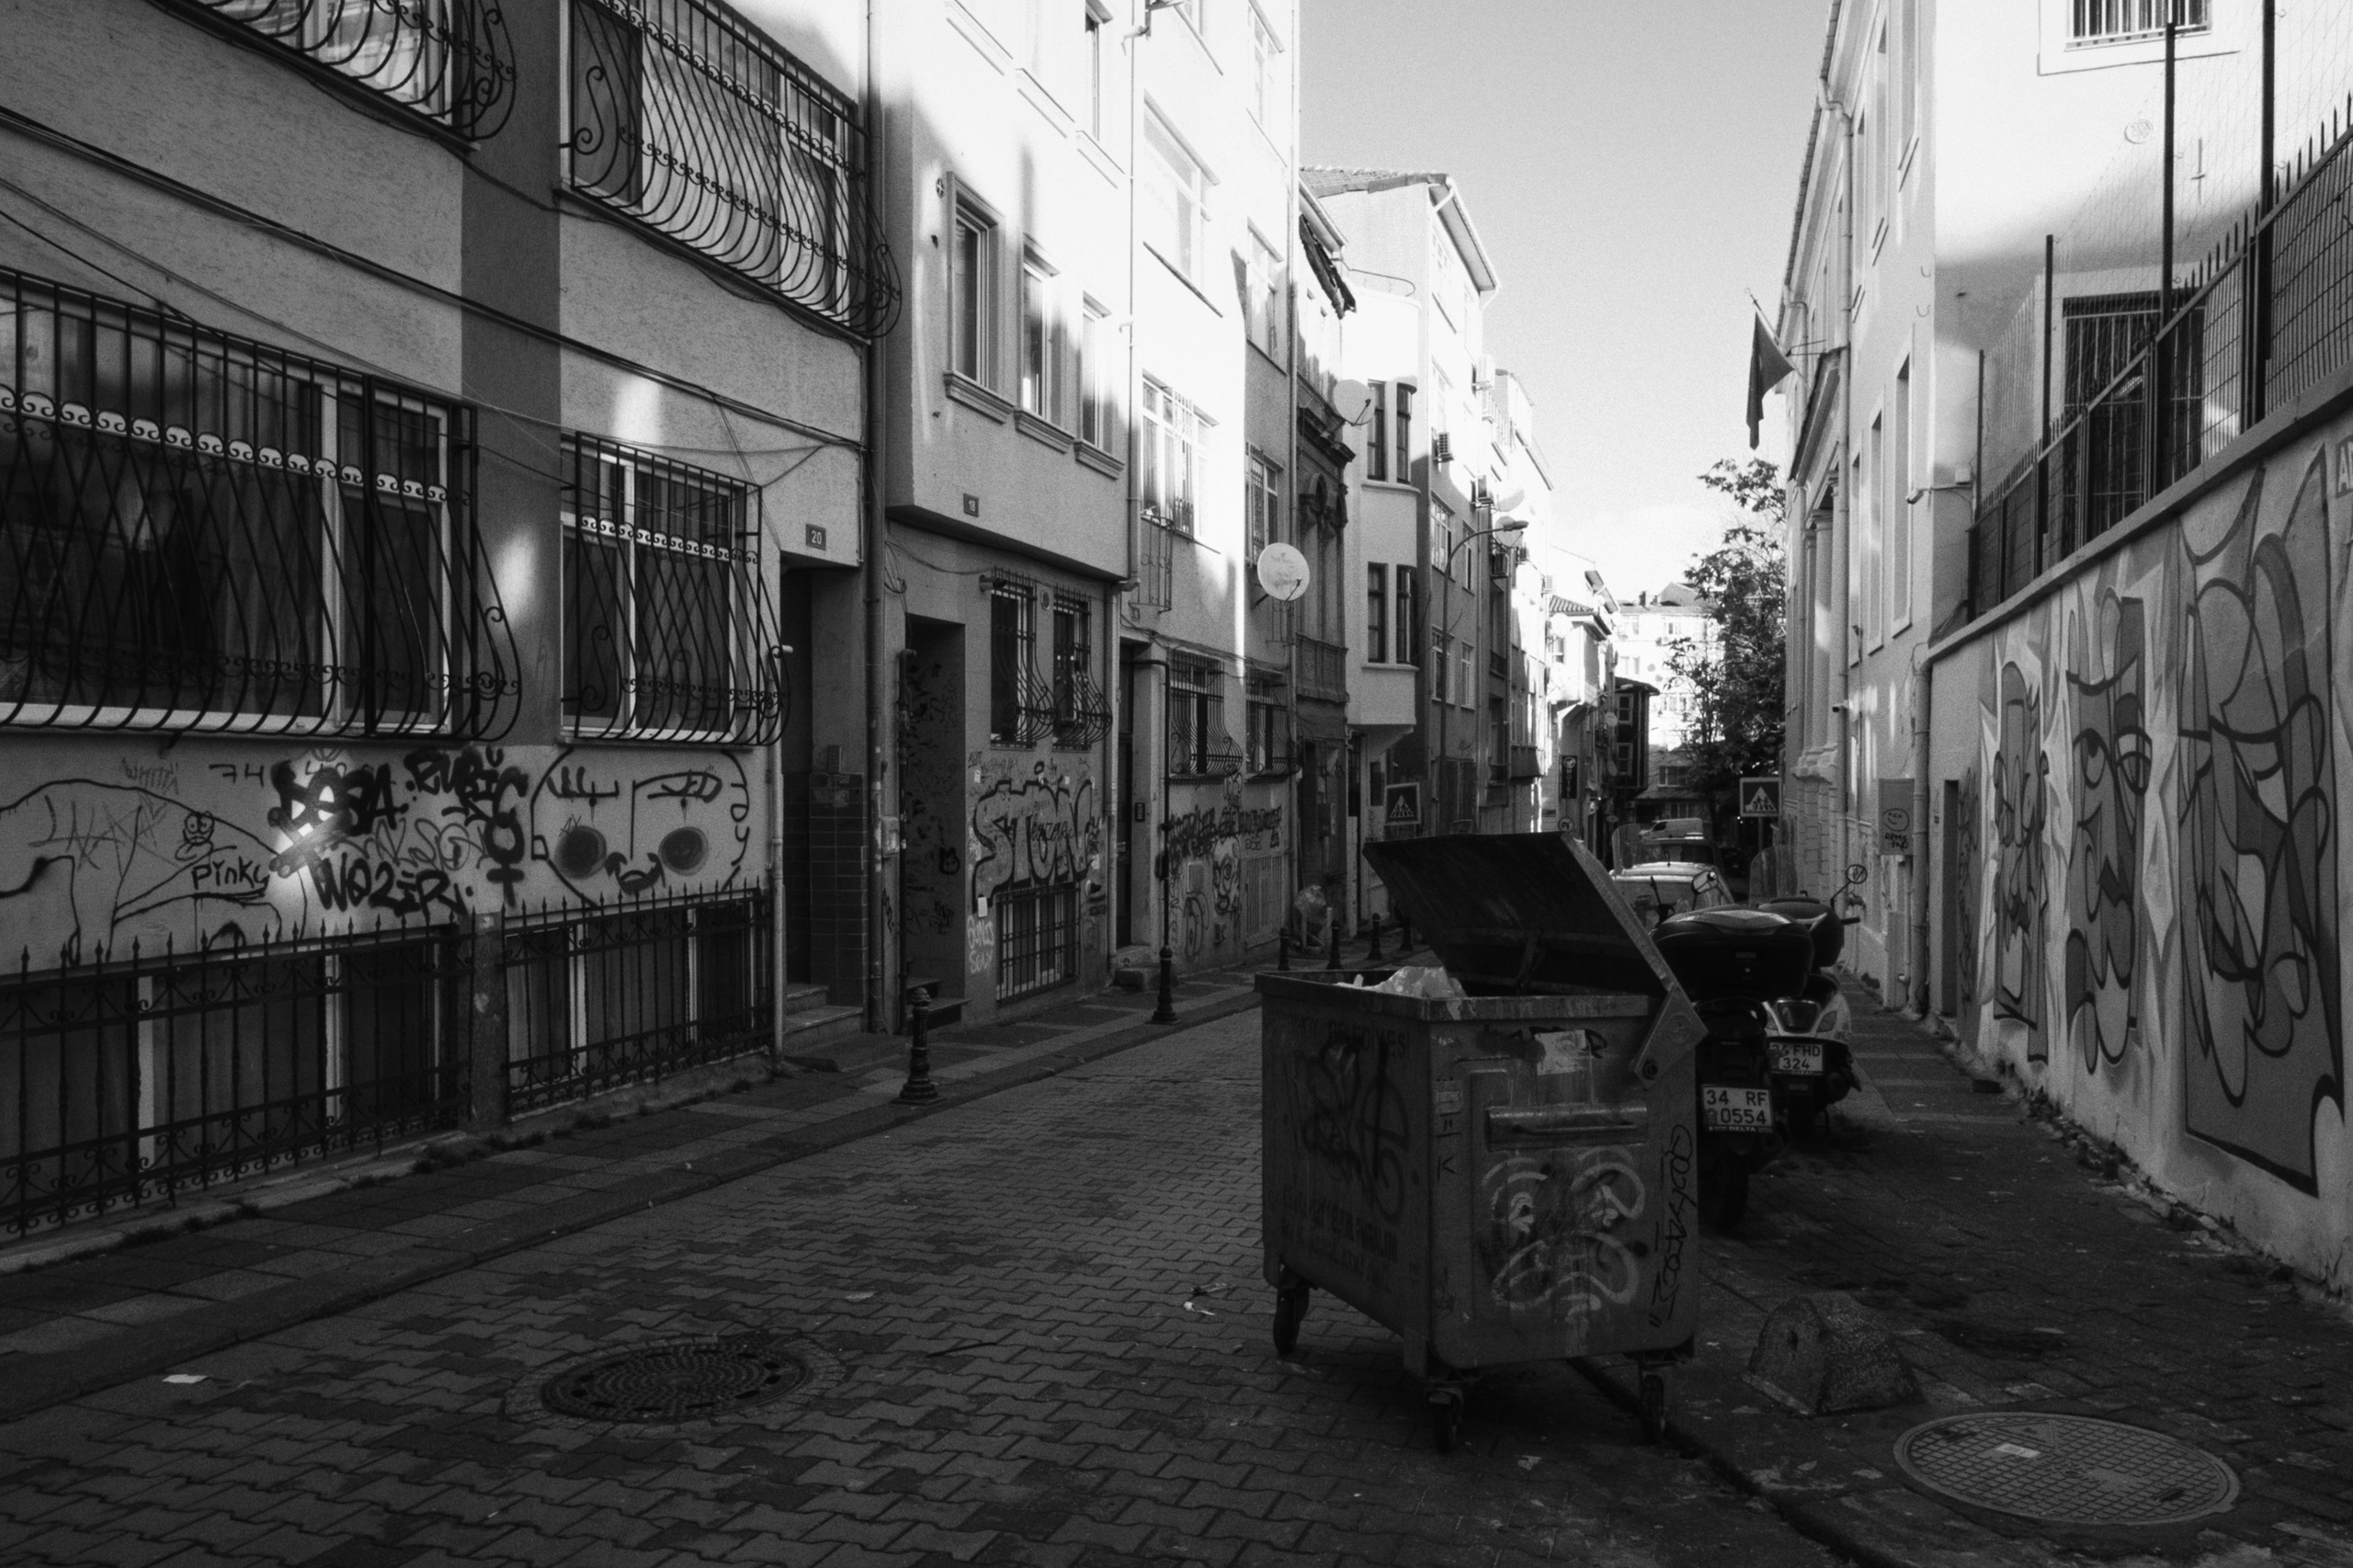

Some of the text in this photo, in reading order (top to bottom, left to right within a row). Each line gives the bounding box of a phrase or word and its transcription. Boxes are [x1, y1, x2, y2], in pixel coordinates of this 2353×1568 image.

[811, 529, 823, 545] 20
[1793, 1044, 1821, 1057] FHD
[1782, 1057, 1810, 1069] 324
[1706, 1089, 1768, 1107] 34 RF
[1721, 1108, 1768, 1124] 0554
